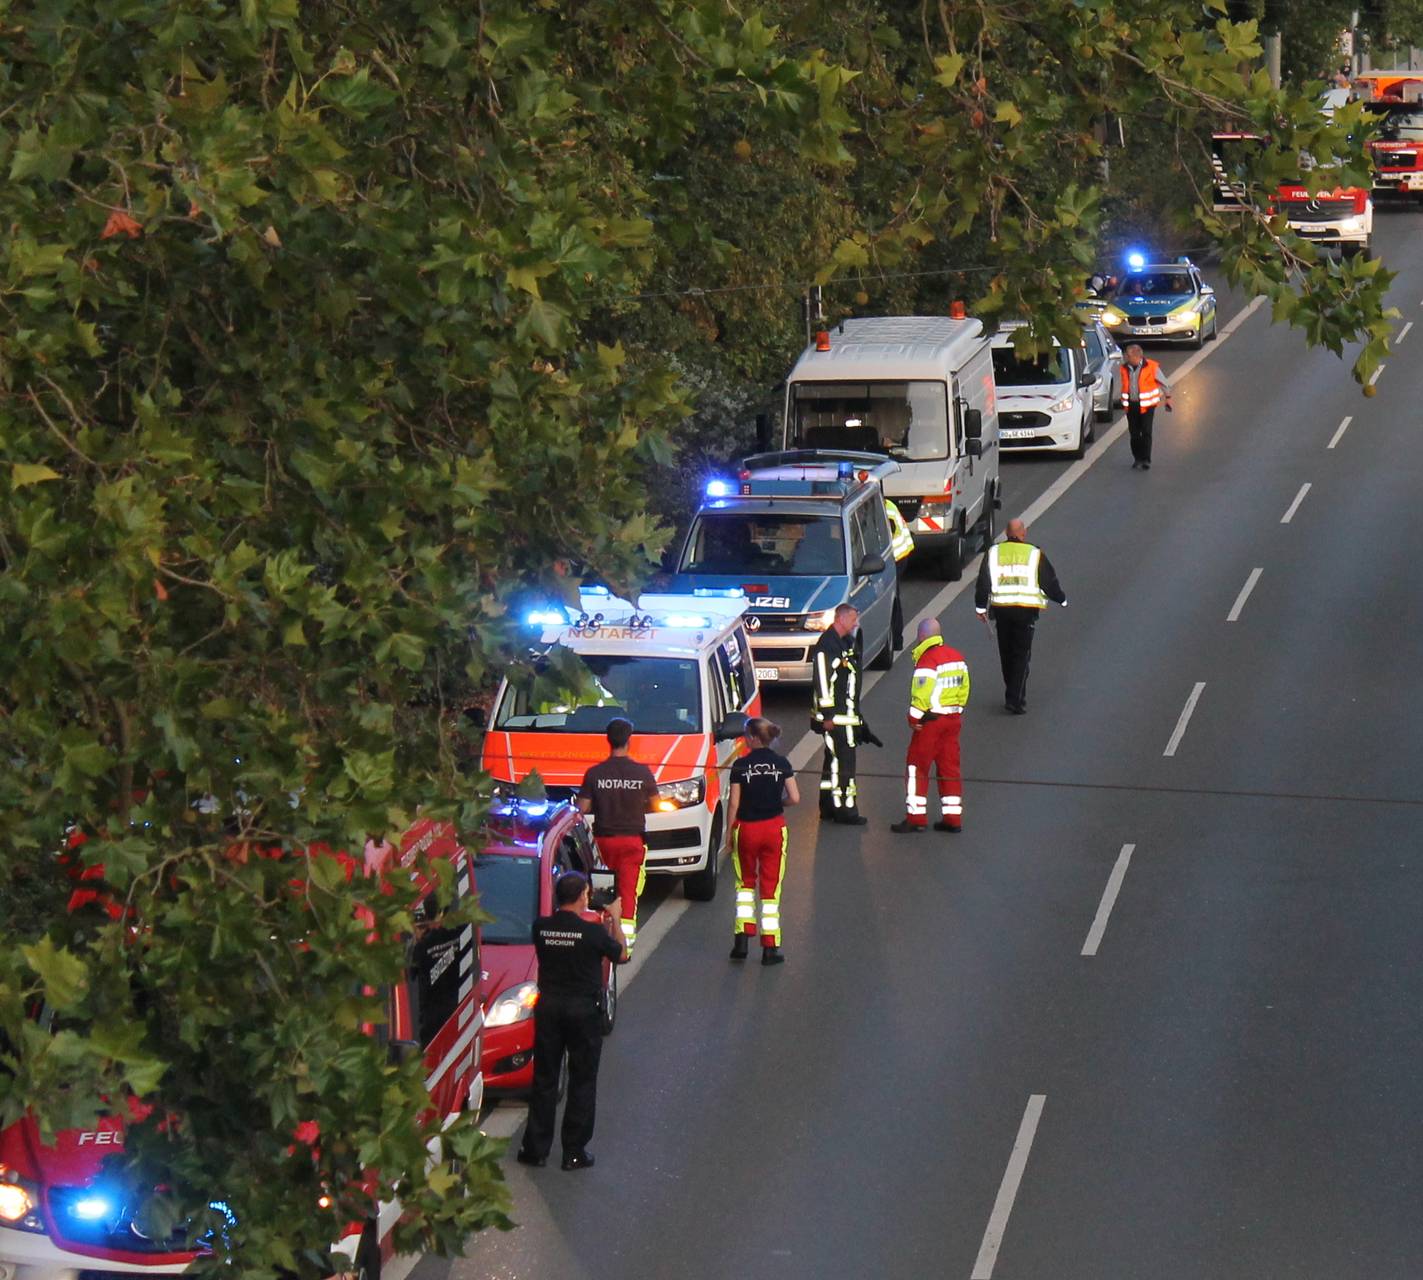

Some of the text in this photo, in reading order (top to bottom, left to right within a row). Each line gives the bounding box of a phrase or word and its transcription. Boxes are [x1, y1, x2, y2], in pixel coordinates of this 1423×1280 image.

[567, 627, 660, 640] NOTARZT
[757, 669, 778, 679] 2003
[597, 778, 644, 791] NOTARZT
[540, 930, 583, 939] FEUERWEHR
[545, 939, 575, 947] BOCHUM
